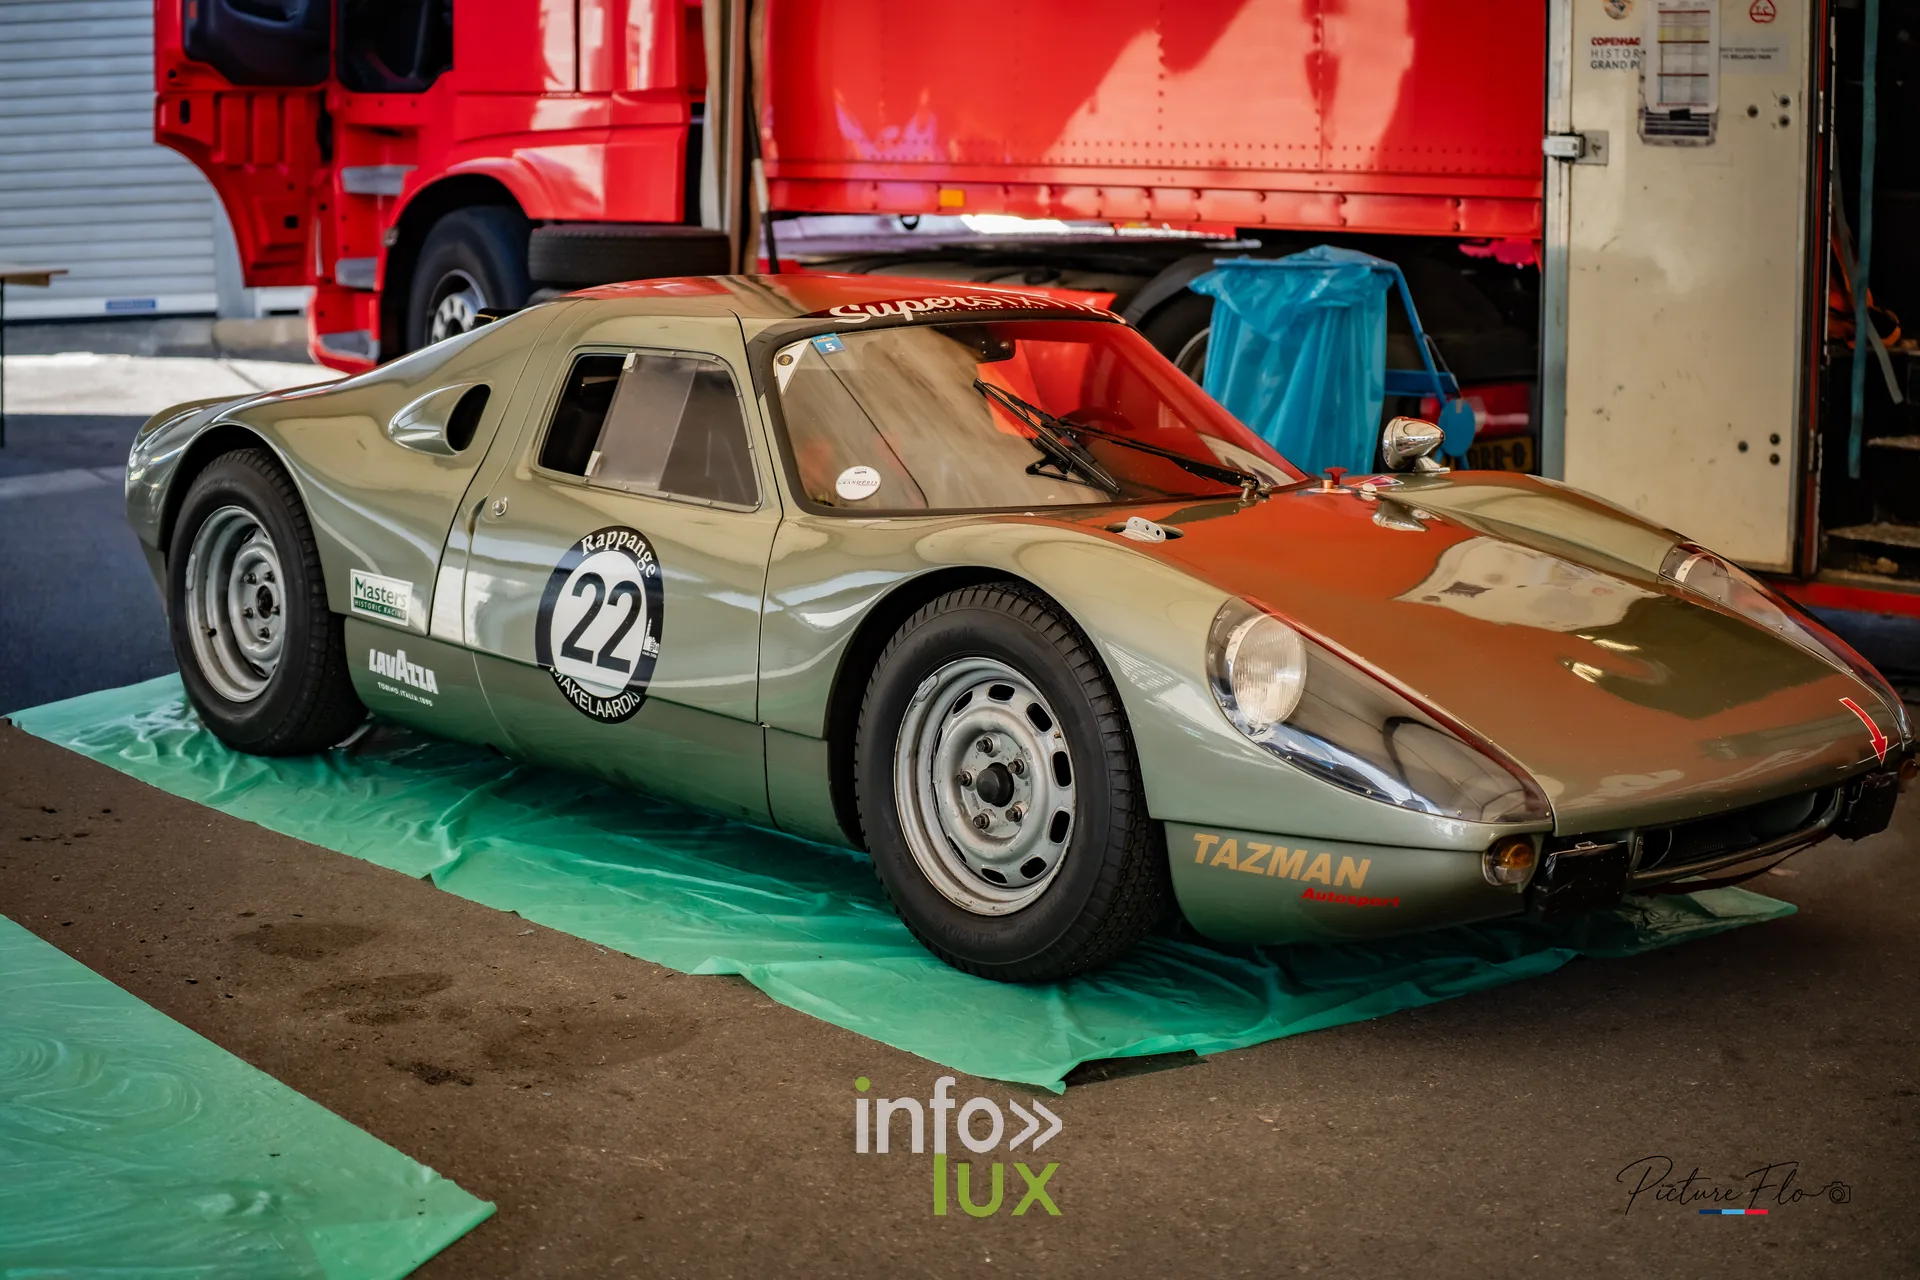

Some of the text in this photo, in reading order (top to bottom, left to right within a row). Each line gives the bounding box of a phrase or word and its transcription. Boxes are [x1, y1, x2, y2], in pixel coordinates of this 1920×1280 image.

[1591, 60, 1628, 69] GRAND
[825, 343, 836, 351] 5
[581, 531, 656, 578] Rappange
[354, 576, 407, 608] Masters
[354, 600, 405, 619] HISTORIC RACING
[560, 571, 642, 674] 22
[1193, 832, 1372, 890] TAZMAN
[1301, 887, 1401, 909] Autosport
